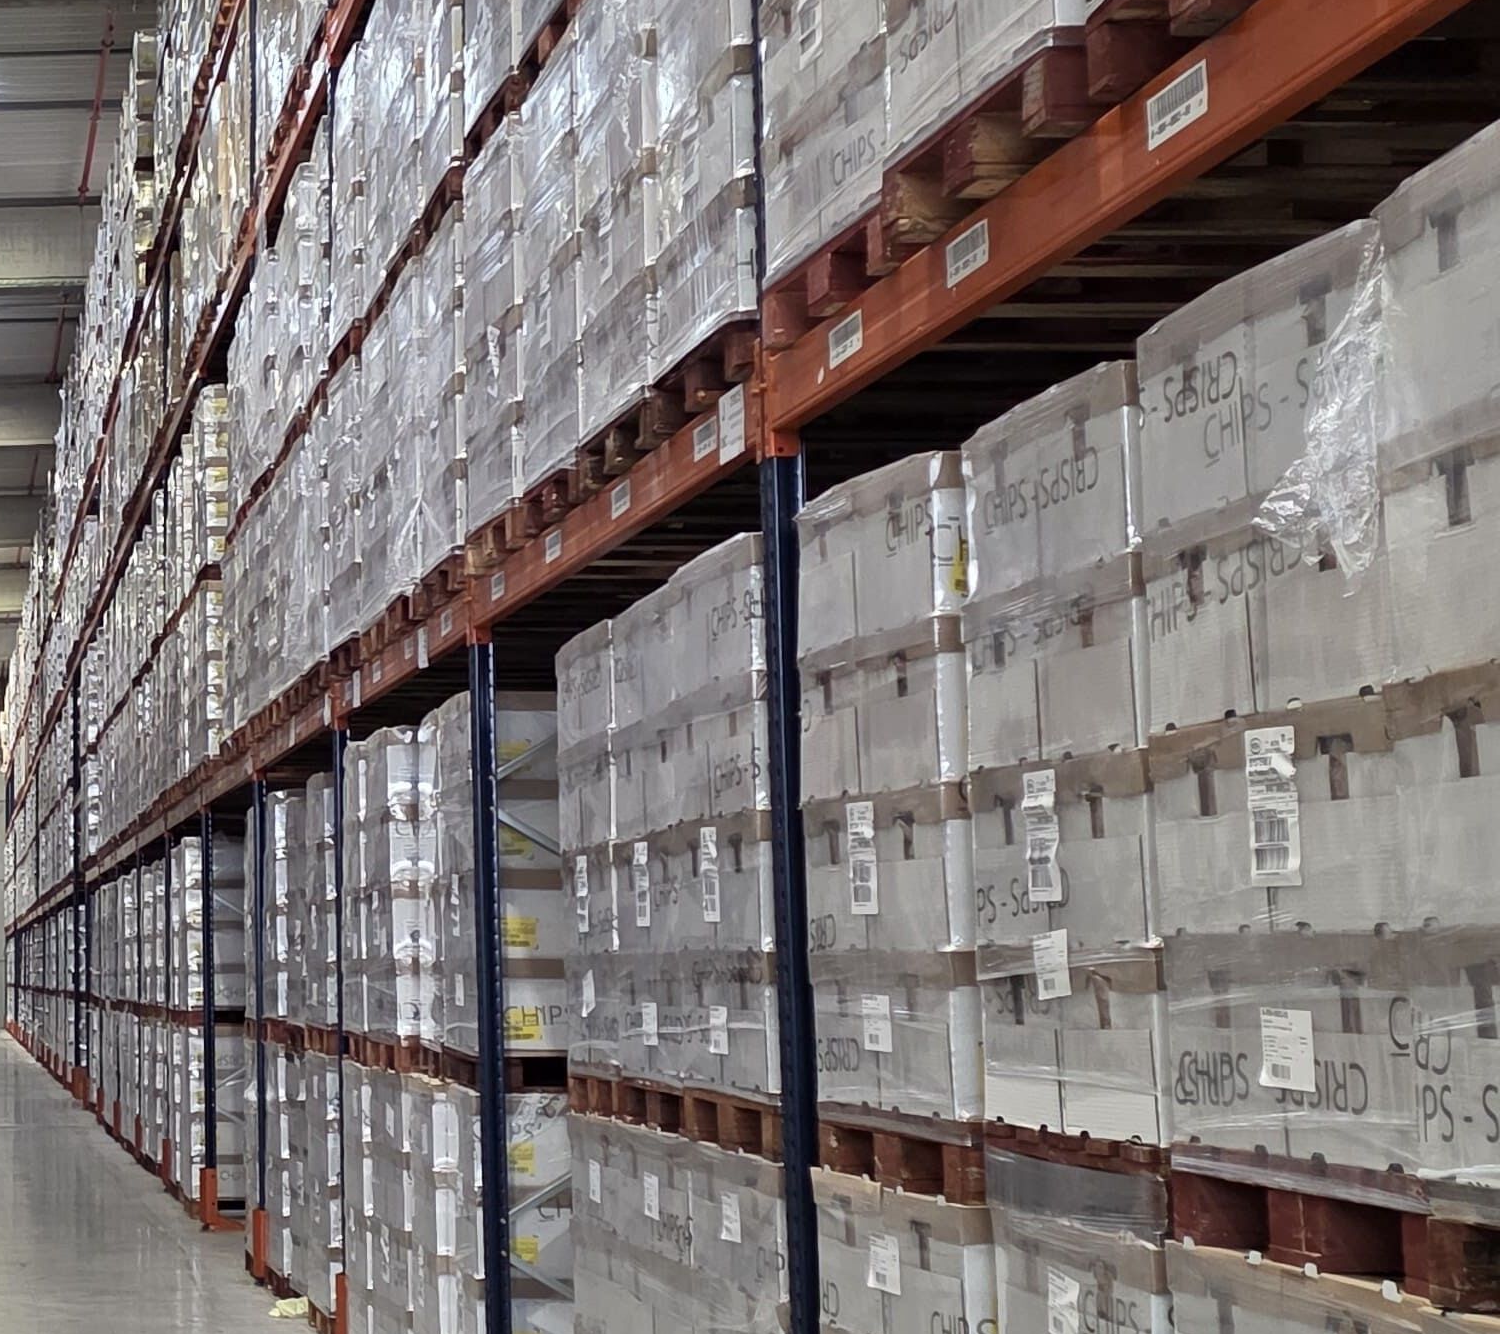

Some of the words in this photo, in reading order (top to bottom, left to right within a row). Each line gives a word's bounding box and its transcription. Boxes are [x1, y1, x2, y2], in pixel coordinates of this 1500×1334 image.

[831, 128, 877, 187] CHIPS
[1163, 350, 1238, 423] CRISPS
[1204, 382, 1273, 461] CHIPS
[984, 479, 1028, 530] CHIPS
[1040, 446, 1099, 510] CRISPS
[504, 1004, 569, 1027] CHIP
